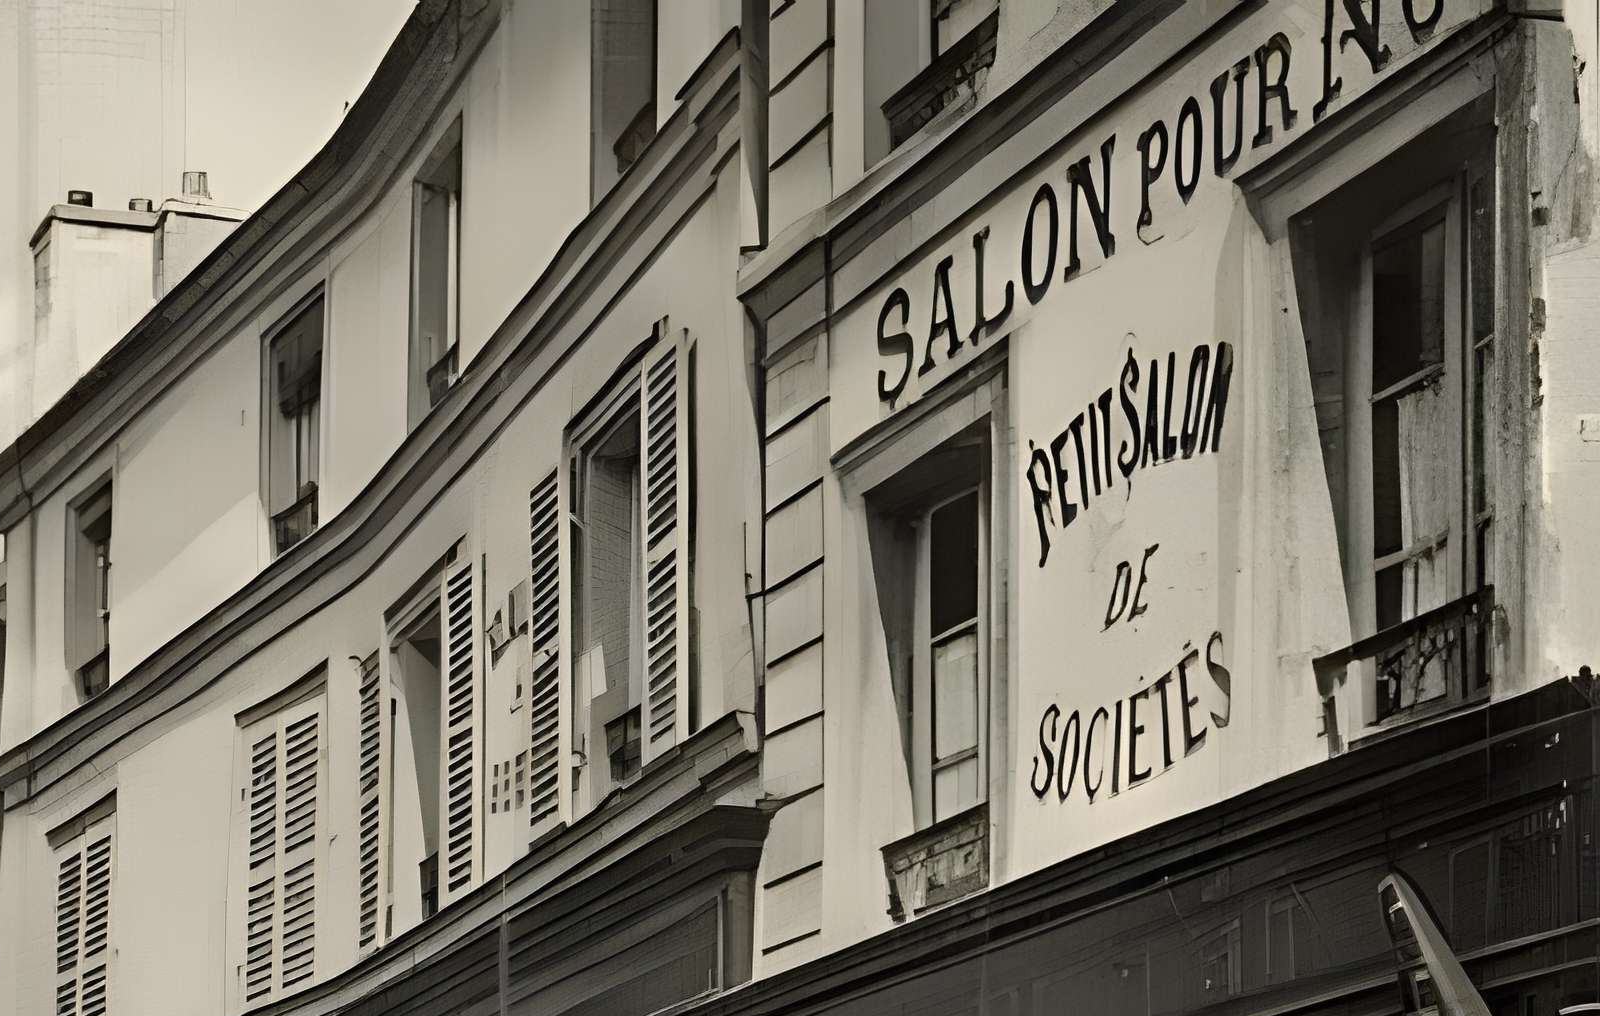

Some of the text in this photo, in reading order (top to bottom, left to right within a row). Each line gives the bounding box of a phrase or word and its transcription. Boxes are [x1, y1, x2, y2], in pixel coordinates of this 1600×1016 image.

[877, 133, 1116, 410] SALON
[1136, 31, 1298, 244] POUR
[1117, 342, 1234, 484] SALON
[1100, 543, 1160, 633] DE
